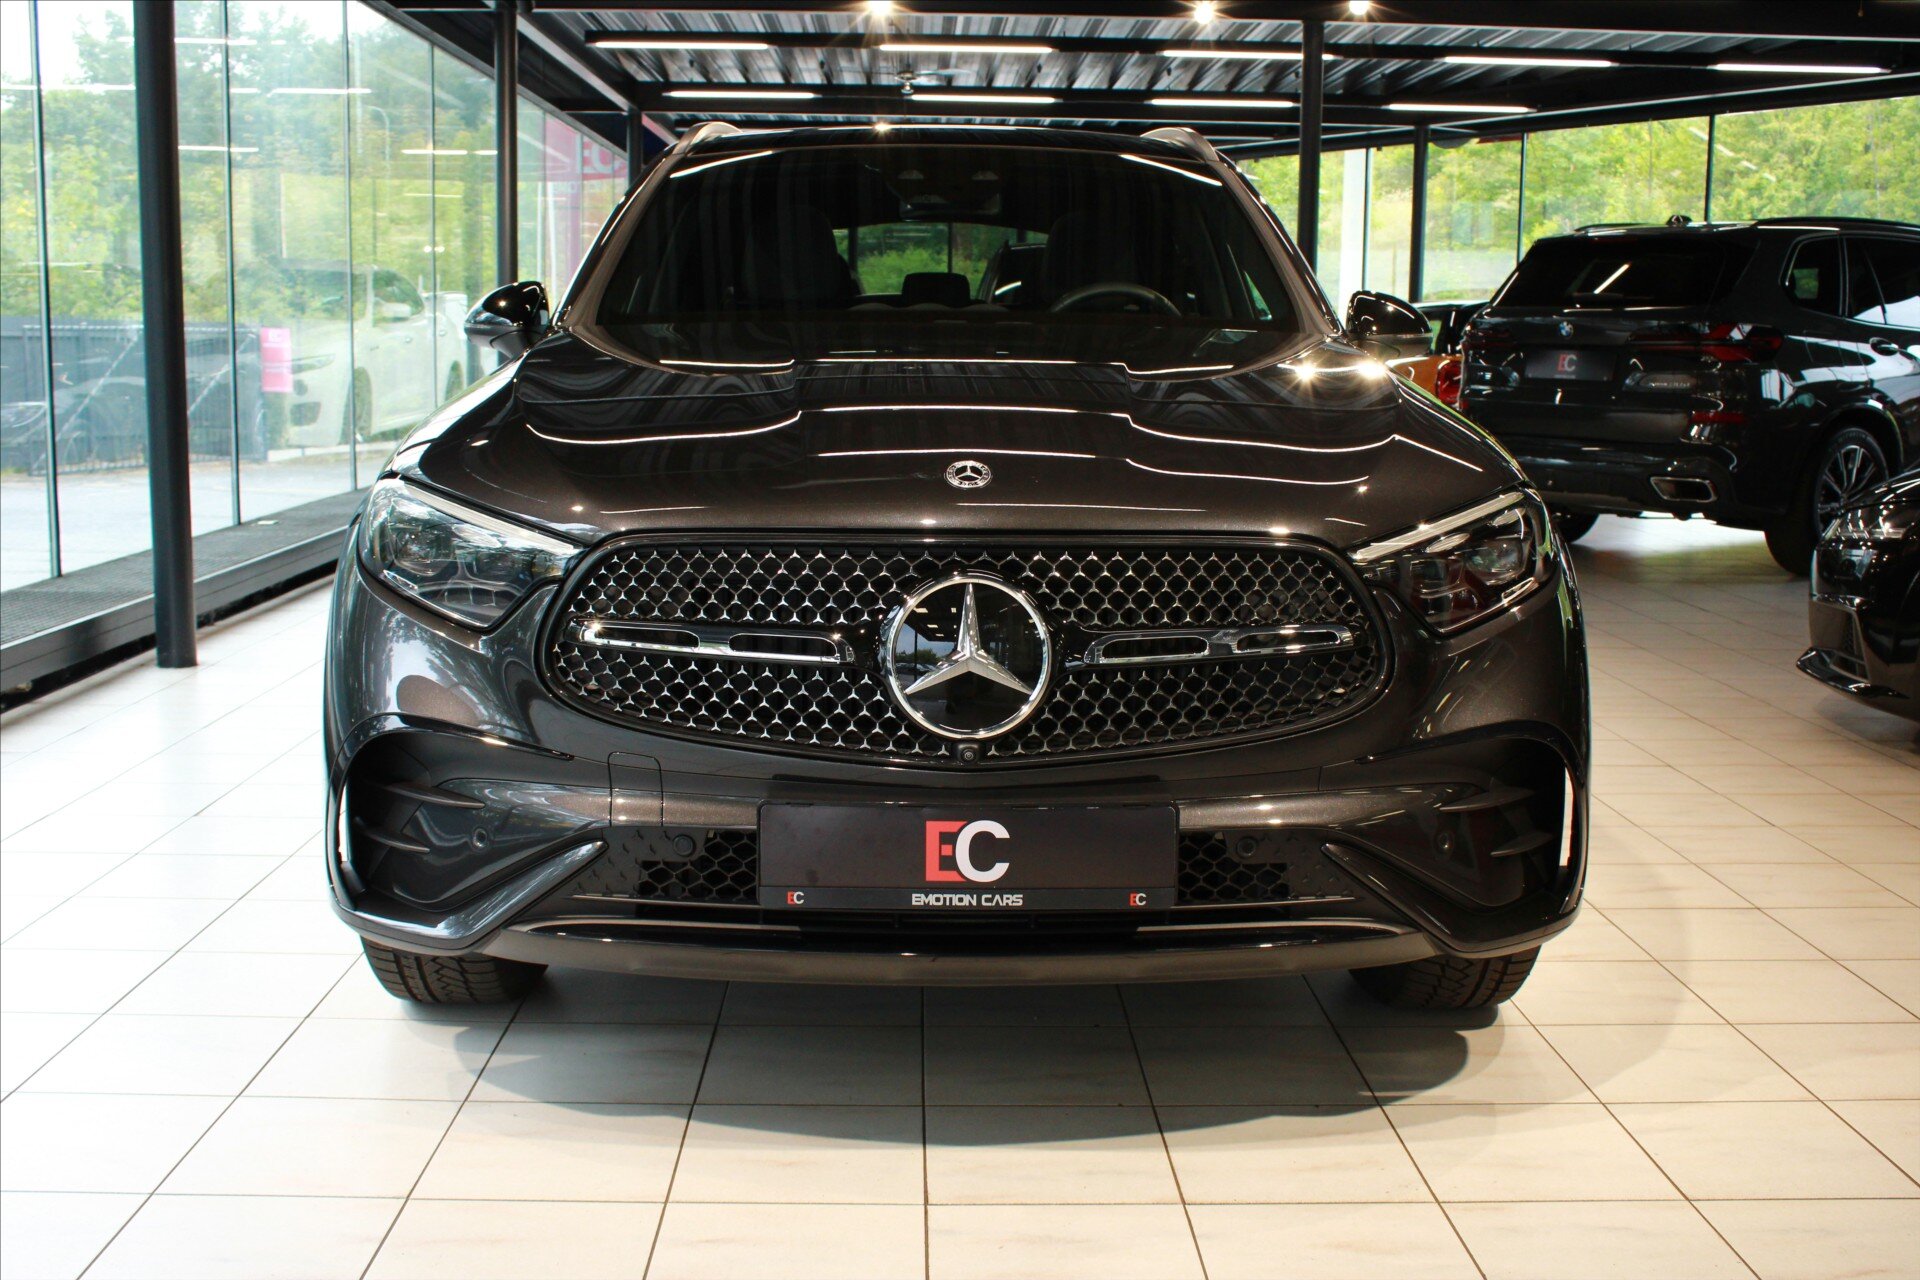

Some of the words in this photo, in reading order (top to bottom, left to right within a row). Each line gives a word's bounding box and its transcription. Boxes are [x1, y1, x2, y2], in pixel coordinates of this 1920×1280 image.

[1558, 354, 1577, 372] EC
[925, 820, 1010, 883] EC
[787, 891, 804, 905] EC
[912, 894, 976, 906] EMOTION
[982, 894, 1023, 906] CARS
[1130, 893, 1147, 906] EC
